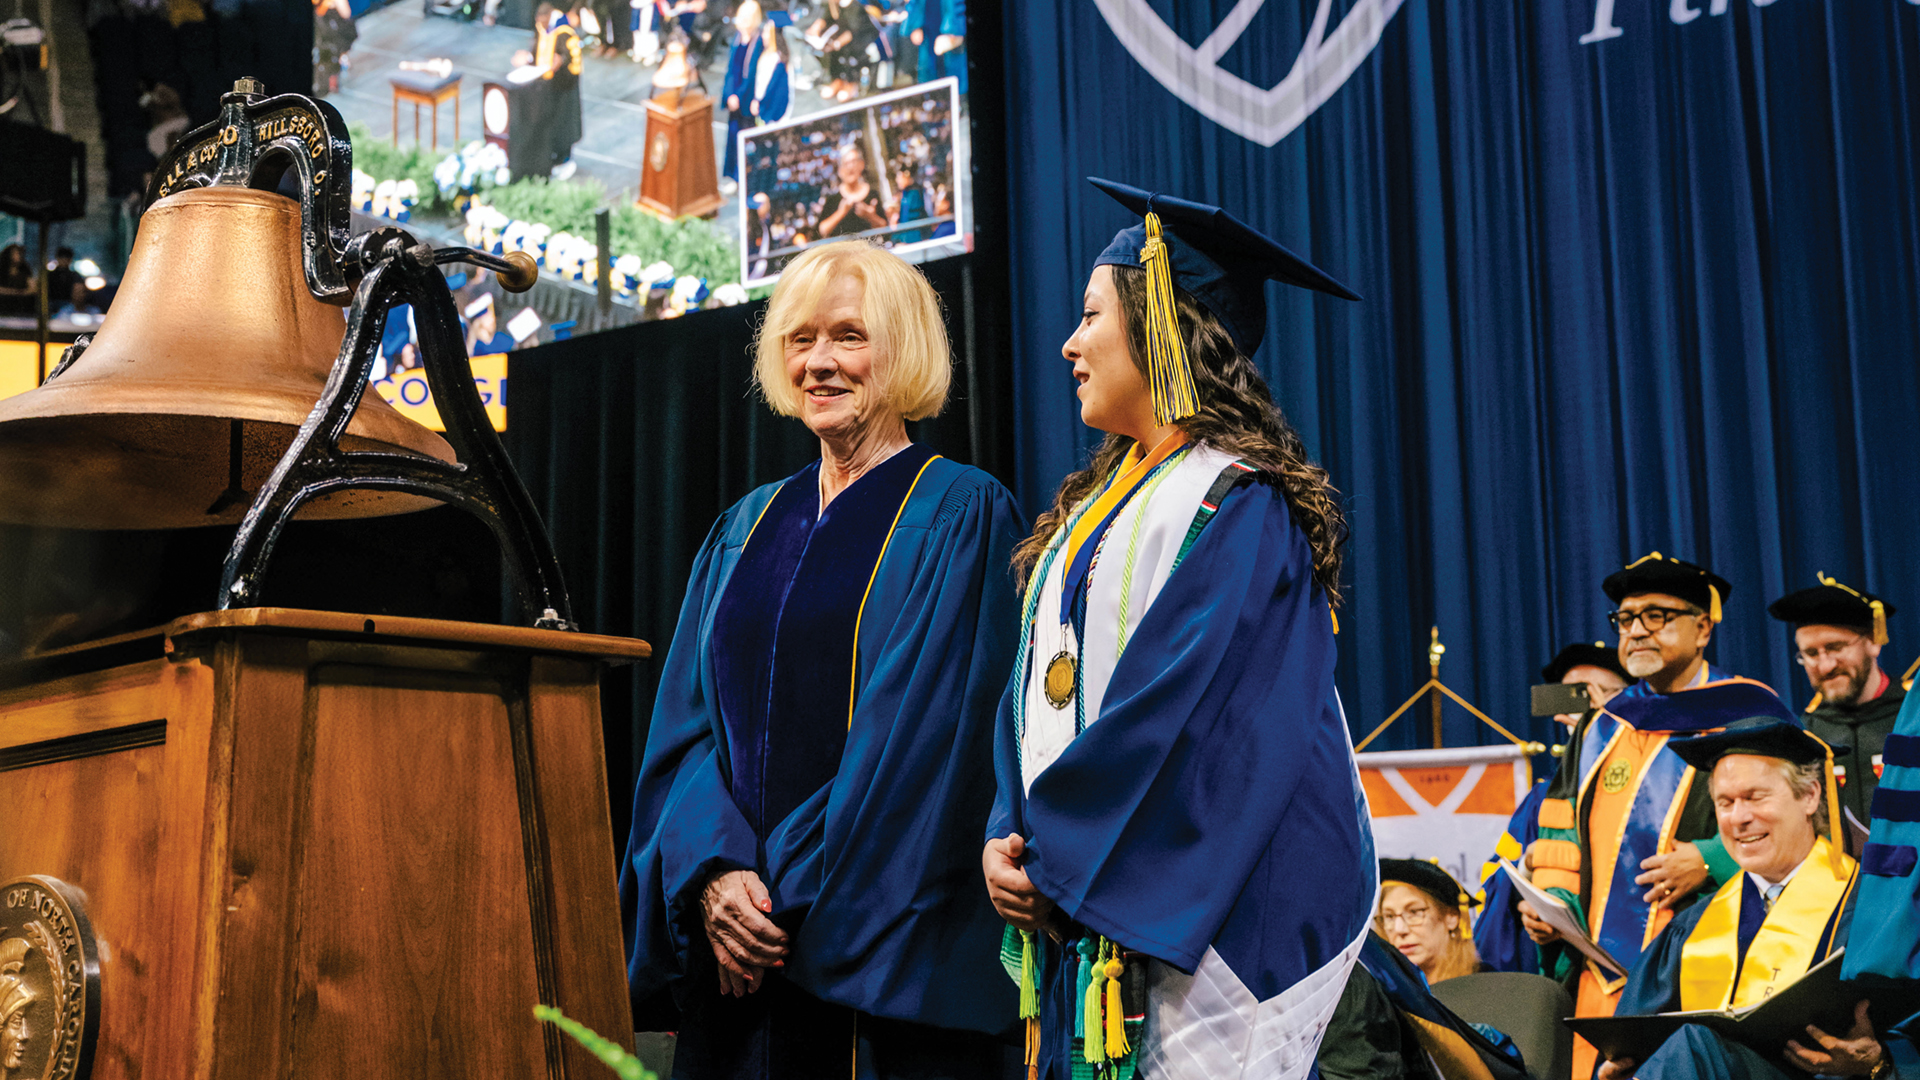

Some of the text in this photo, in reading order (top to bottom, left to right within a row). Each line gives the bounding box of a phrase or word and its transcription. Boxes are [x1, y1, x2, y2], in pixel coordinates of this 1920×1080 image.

[159, 162, 184, 198] ELL
[259, 115, 324, 158] HILLSBORO
[7, 888, 29, 908] OF
[30, 890, 76, 956] NORTH
